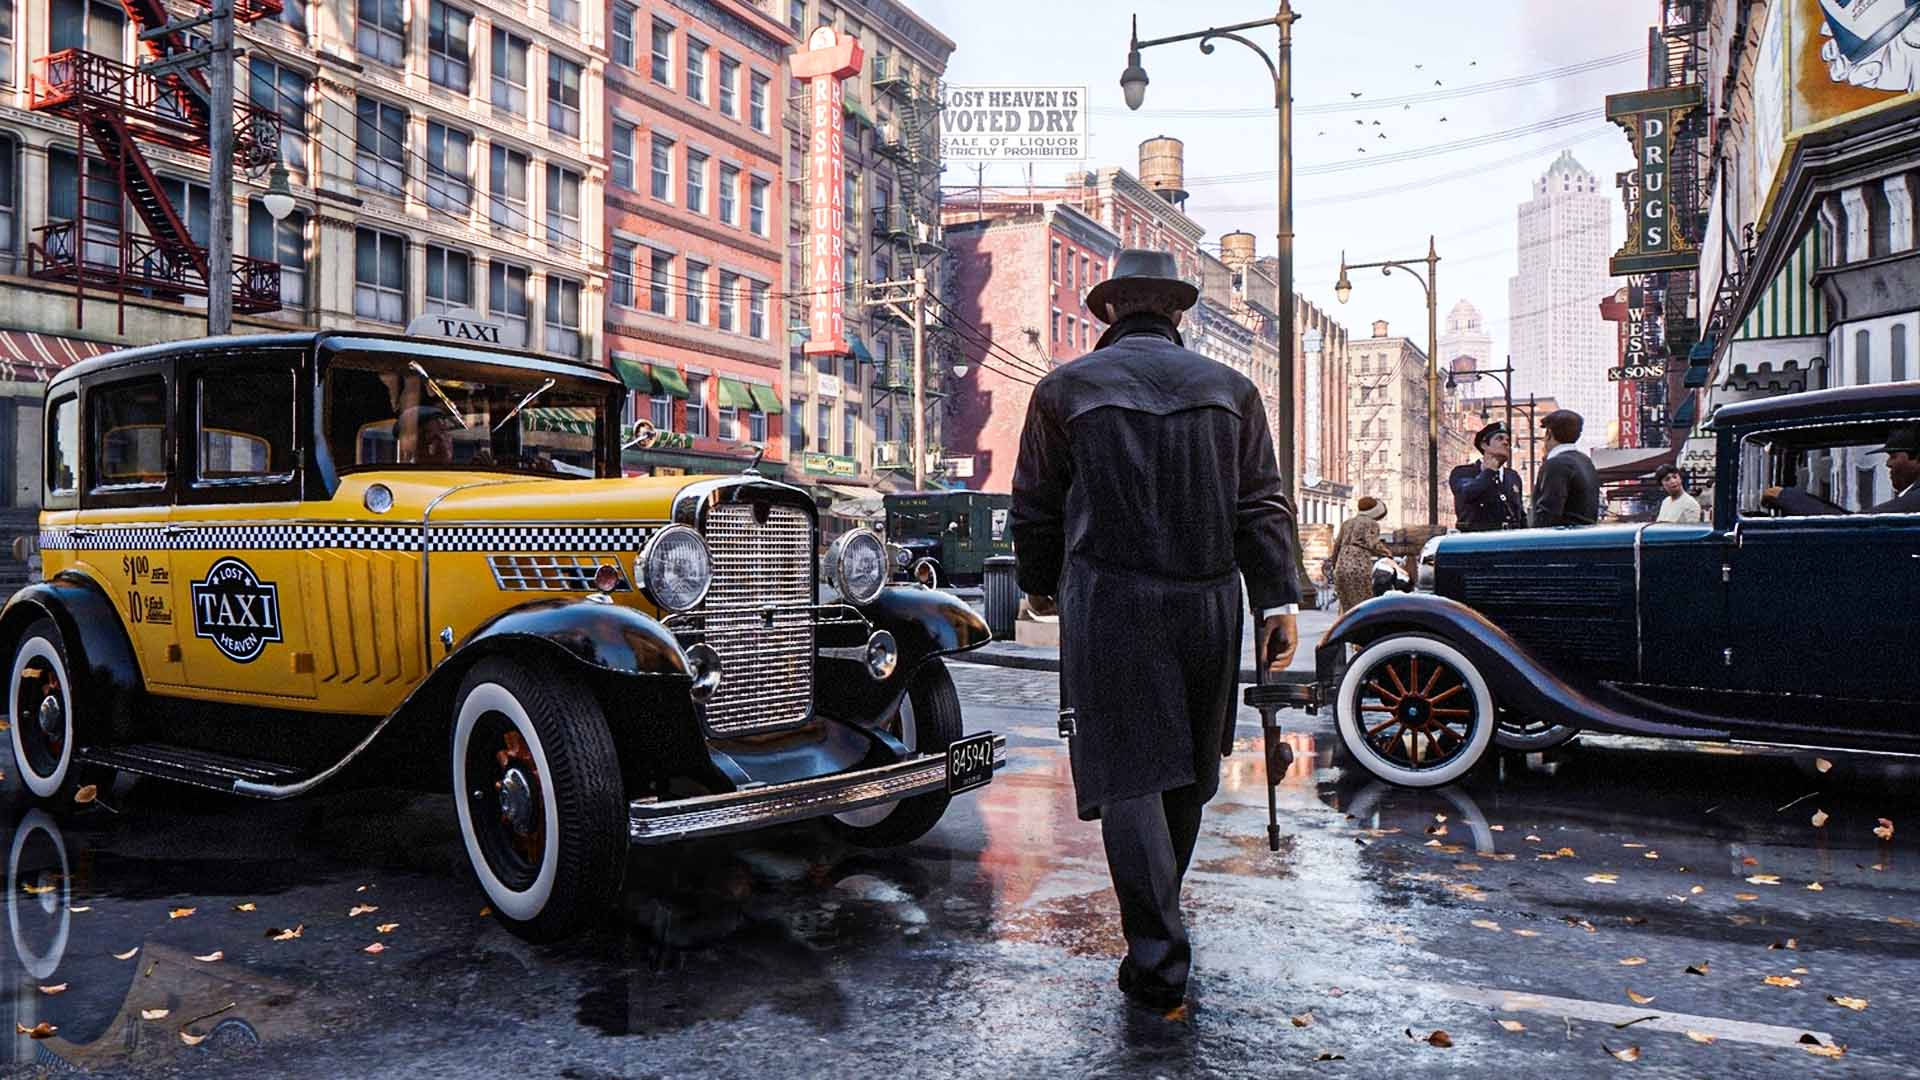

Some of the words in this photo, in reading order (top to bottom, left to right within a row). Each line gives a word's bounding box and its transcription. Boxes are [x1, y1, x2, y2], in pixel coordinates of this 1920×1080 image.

[989, 91, 1058, 107] HEAVEN
[1062, 91, 1078, 107] IS
[942, 110, 1021, 132] VOTED
[1028, 110, 1078, 132] DRY
[942, 137, 979, 146] SALE
[990, 137, 1009, 146] OF
[1020, 137, 1078, 147] LIQUOR
[1004, 147, 1078, 156] PROHIBITED
[1645, 119, 1663, 246] DRUGS
[815, 79, 828, 334] RESTAURANT
[831, 81, 841, 335] RESTAURANT
[438, 319, 500, 343] TAXI
[1628, 308, 1645, 365] WEST
[1624, 366, 1664, 378] SONS
[220, 567, 244, 581] LOST
[199, 593, 275, 628] TAXI
[220, 632, 258, 653] HEAVEN
[953, 741, 991, 776] 845942
